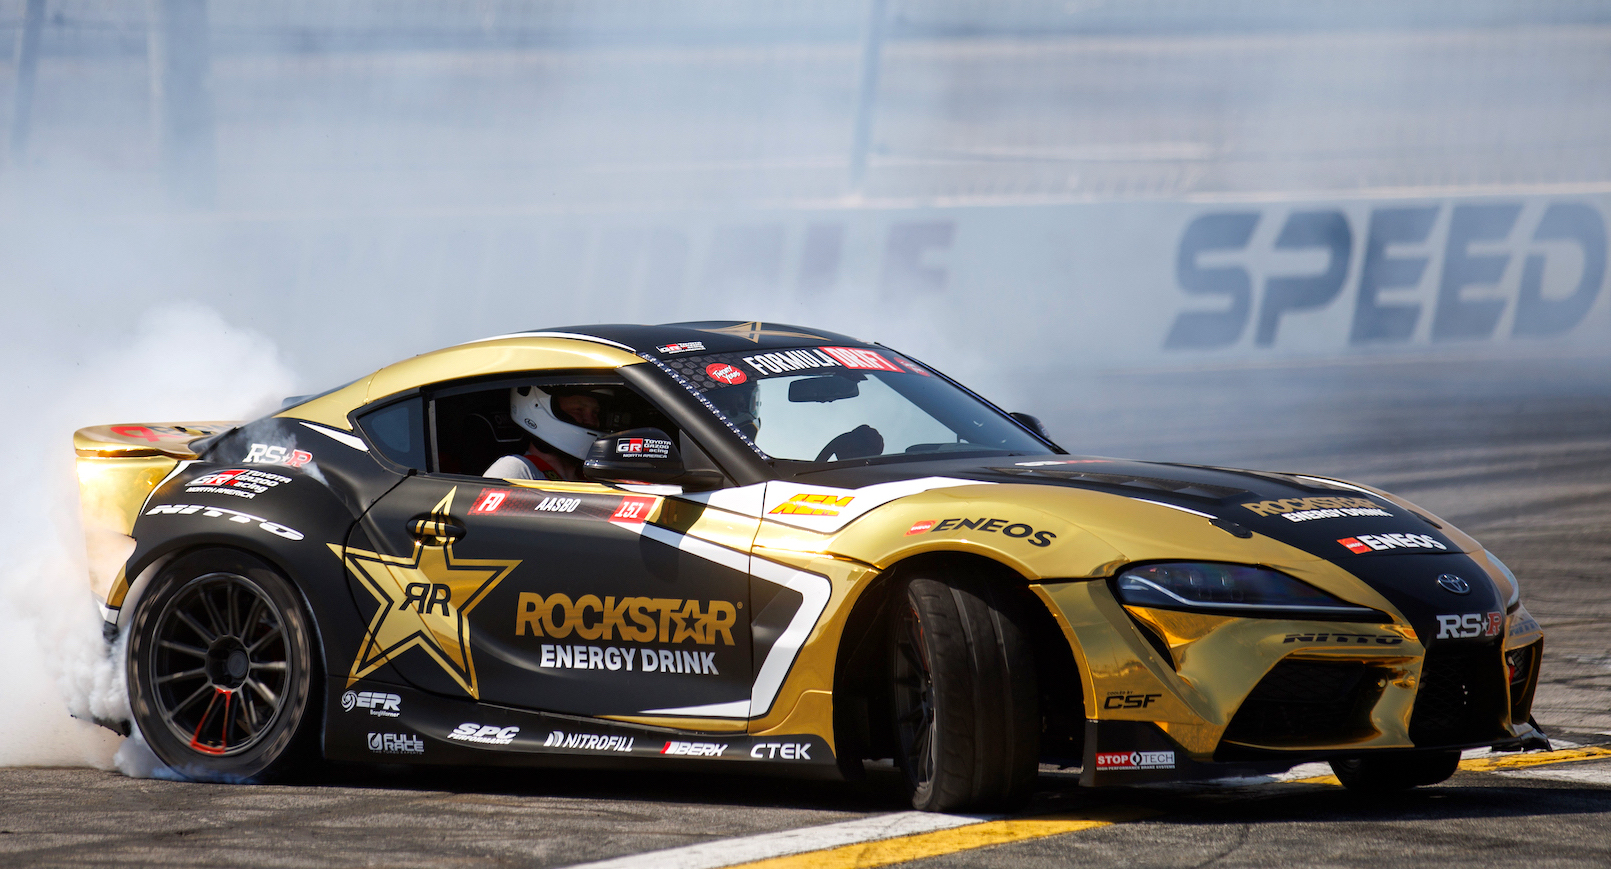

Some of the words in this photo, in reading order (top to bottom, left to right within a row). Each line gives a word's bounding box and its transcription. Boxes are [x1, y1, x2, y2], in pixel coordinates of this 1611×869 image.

[1160, 204, 1608, 351] SPEED
[743, 349, 842, 375] FORMULA
[824, 348, 898, 370] DRIFT
[234, 474, 279, 486] GAZOO
[246, 470, 292, 484] TOYOTA
[215, 488, 256, 499] AMERICA
[478, 492, 506, 512] FD
[534, 497, 582, 512] AASBO
[614, 502, 644, 518] 151
[1241, 496, 1387, 517] ROCKSTAR
[146, 504, 304, 540] NITTO
[1281, 509, 1347, 523] ENERGY
[1344, 508, 1394, 518] DRINK
[931, 518, 1056, 547] ENEOS
[1356, 533, 1448, 551] ENEOS
[515, 592, 737, 646] ROCKSTAR
[1283, 632, 1403, 644] NITTO
[540, 644, 636, 672] ENERGY
[641, 648, 719, 676] DRINK
[356, 691, 402, 712] EFR
[1104, 694, 1162, 710] CSF
[384, 733, 424, 744] FULL
[447, 733, 514, 745] PERFORMANCE
[453, 722, 520, 739] SPC
[384, 742, 424, 752] RACE
[562, 733, 634, 752] NITROFILL
[674, 742, 728, 757] BERK
[750, 743, 812, 760] CTEK
[1097, 755, 1129, 765] STOP
